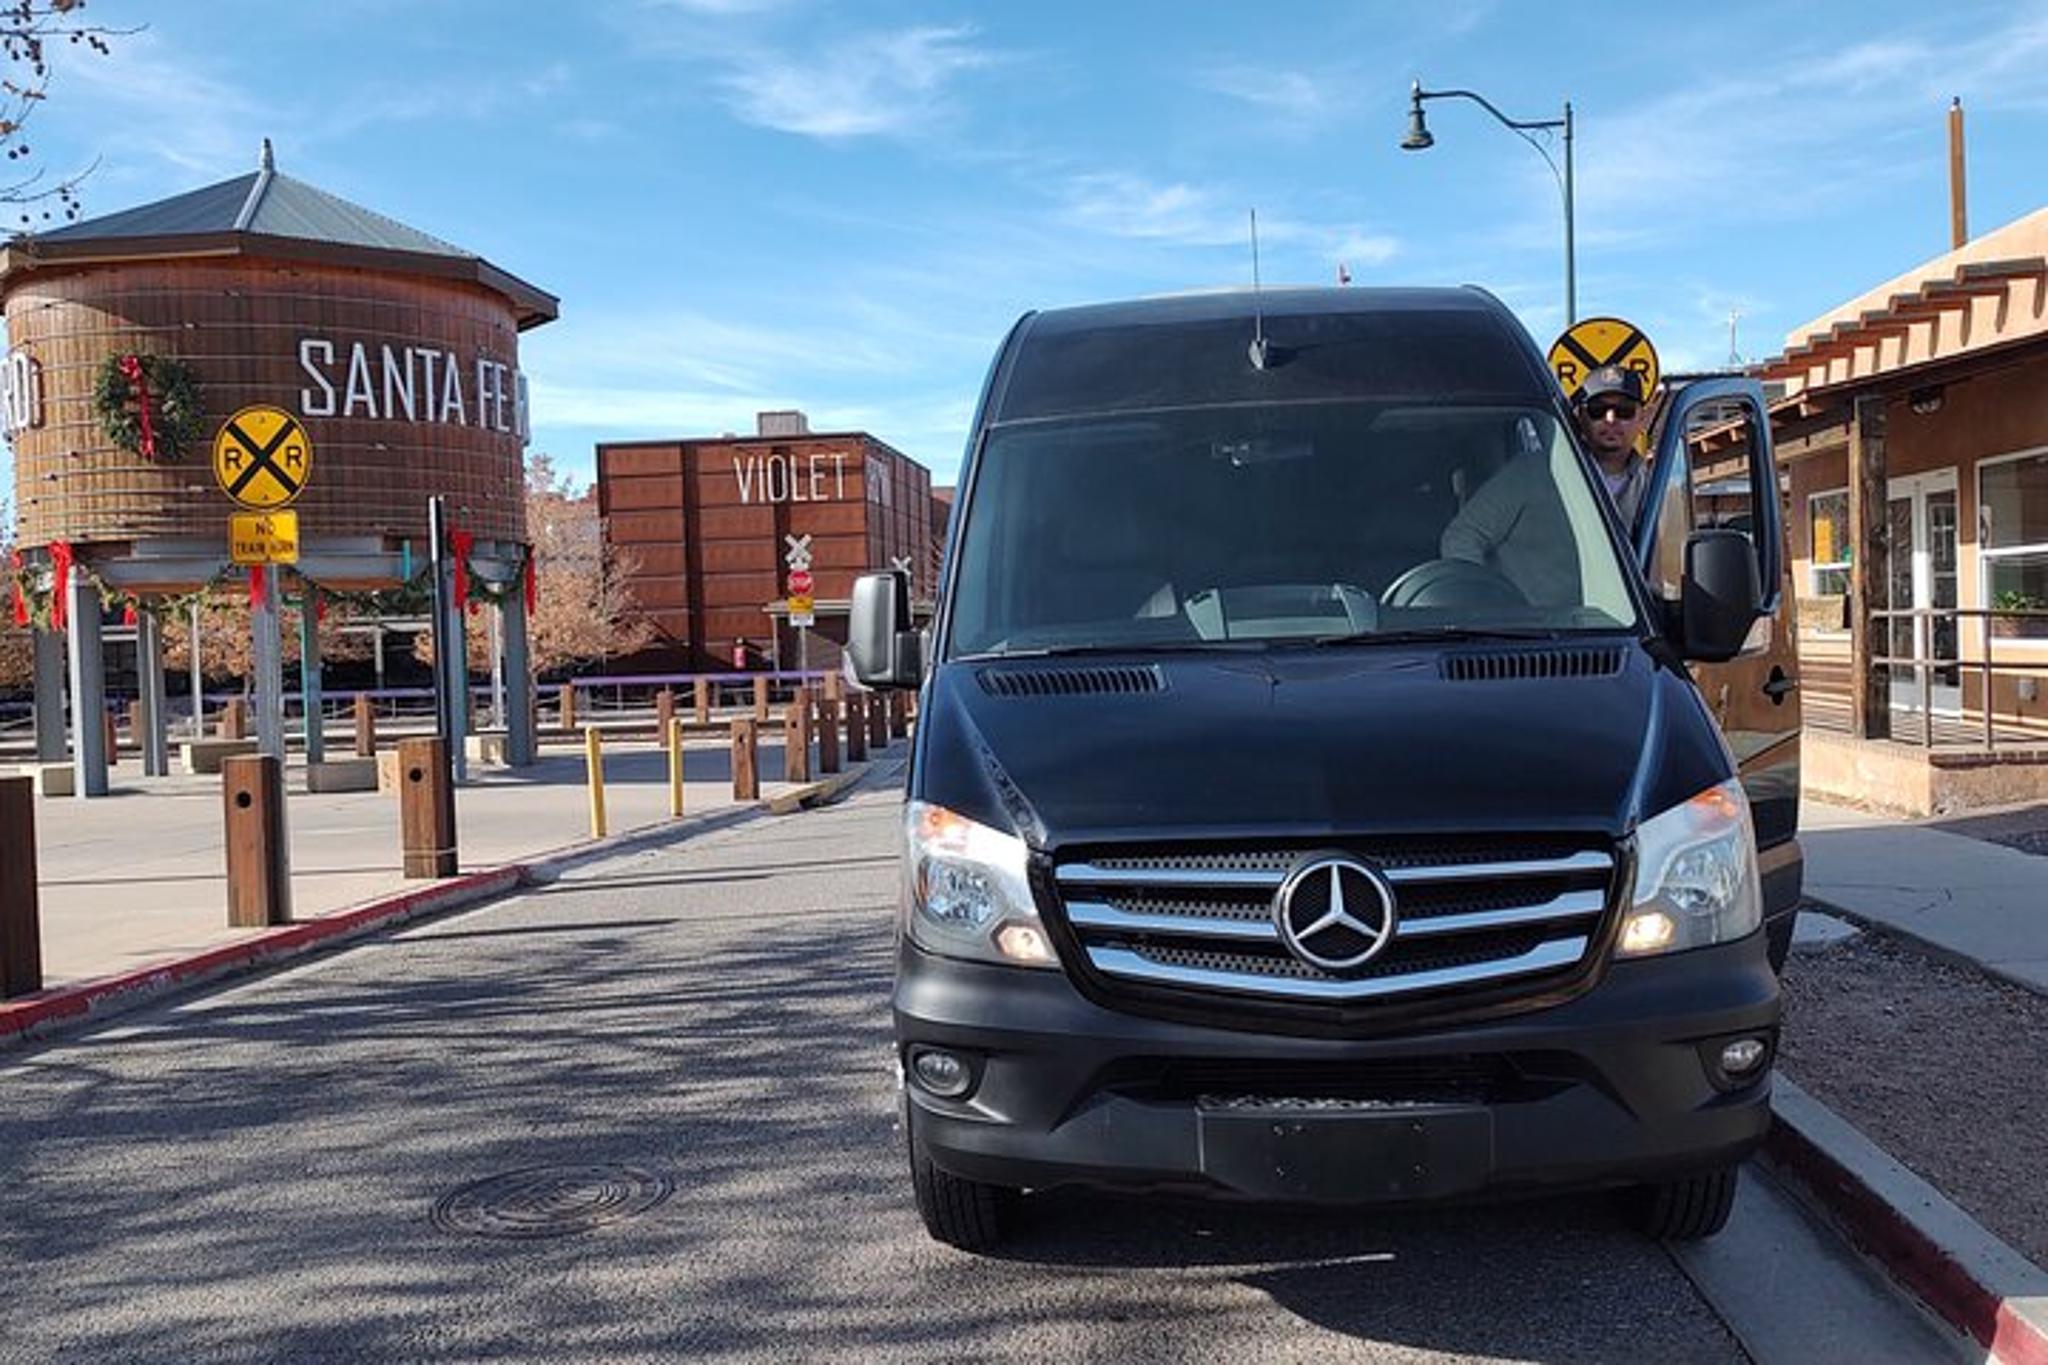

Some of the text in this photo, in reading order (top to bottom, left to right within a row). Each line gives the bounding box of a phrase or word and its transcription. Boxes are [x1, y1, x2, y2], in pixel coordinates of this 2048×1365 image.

[300, 339, 467, 426] SANTA
[477, 359, 511, 433] FE
[224, 445, 303, 470] R R
[733, 452, 849, 505] VIOLET
[255, 521, 276, 536] NO
